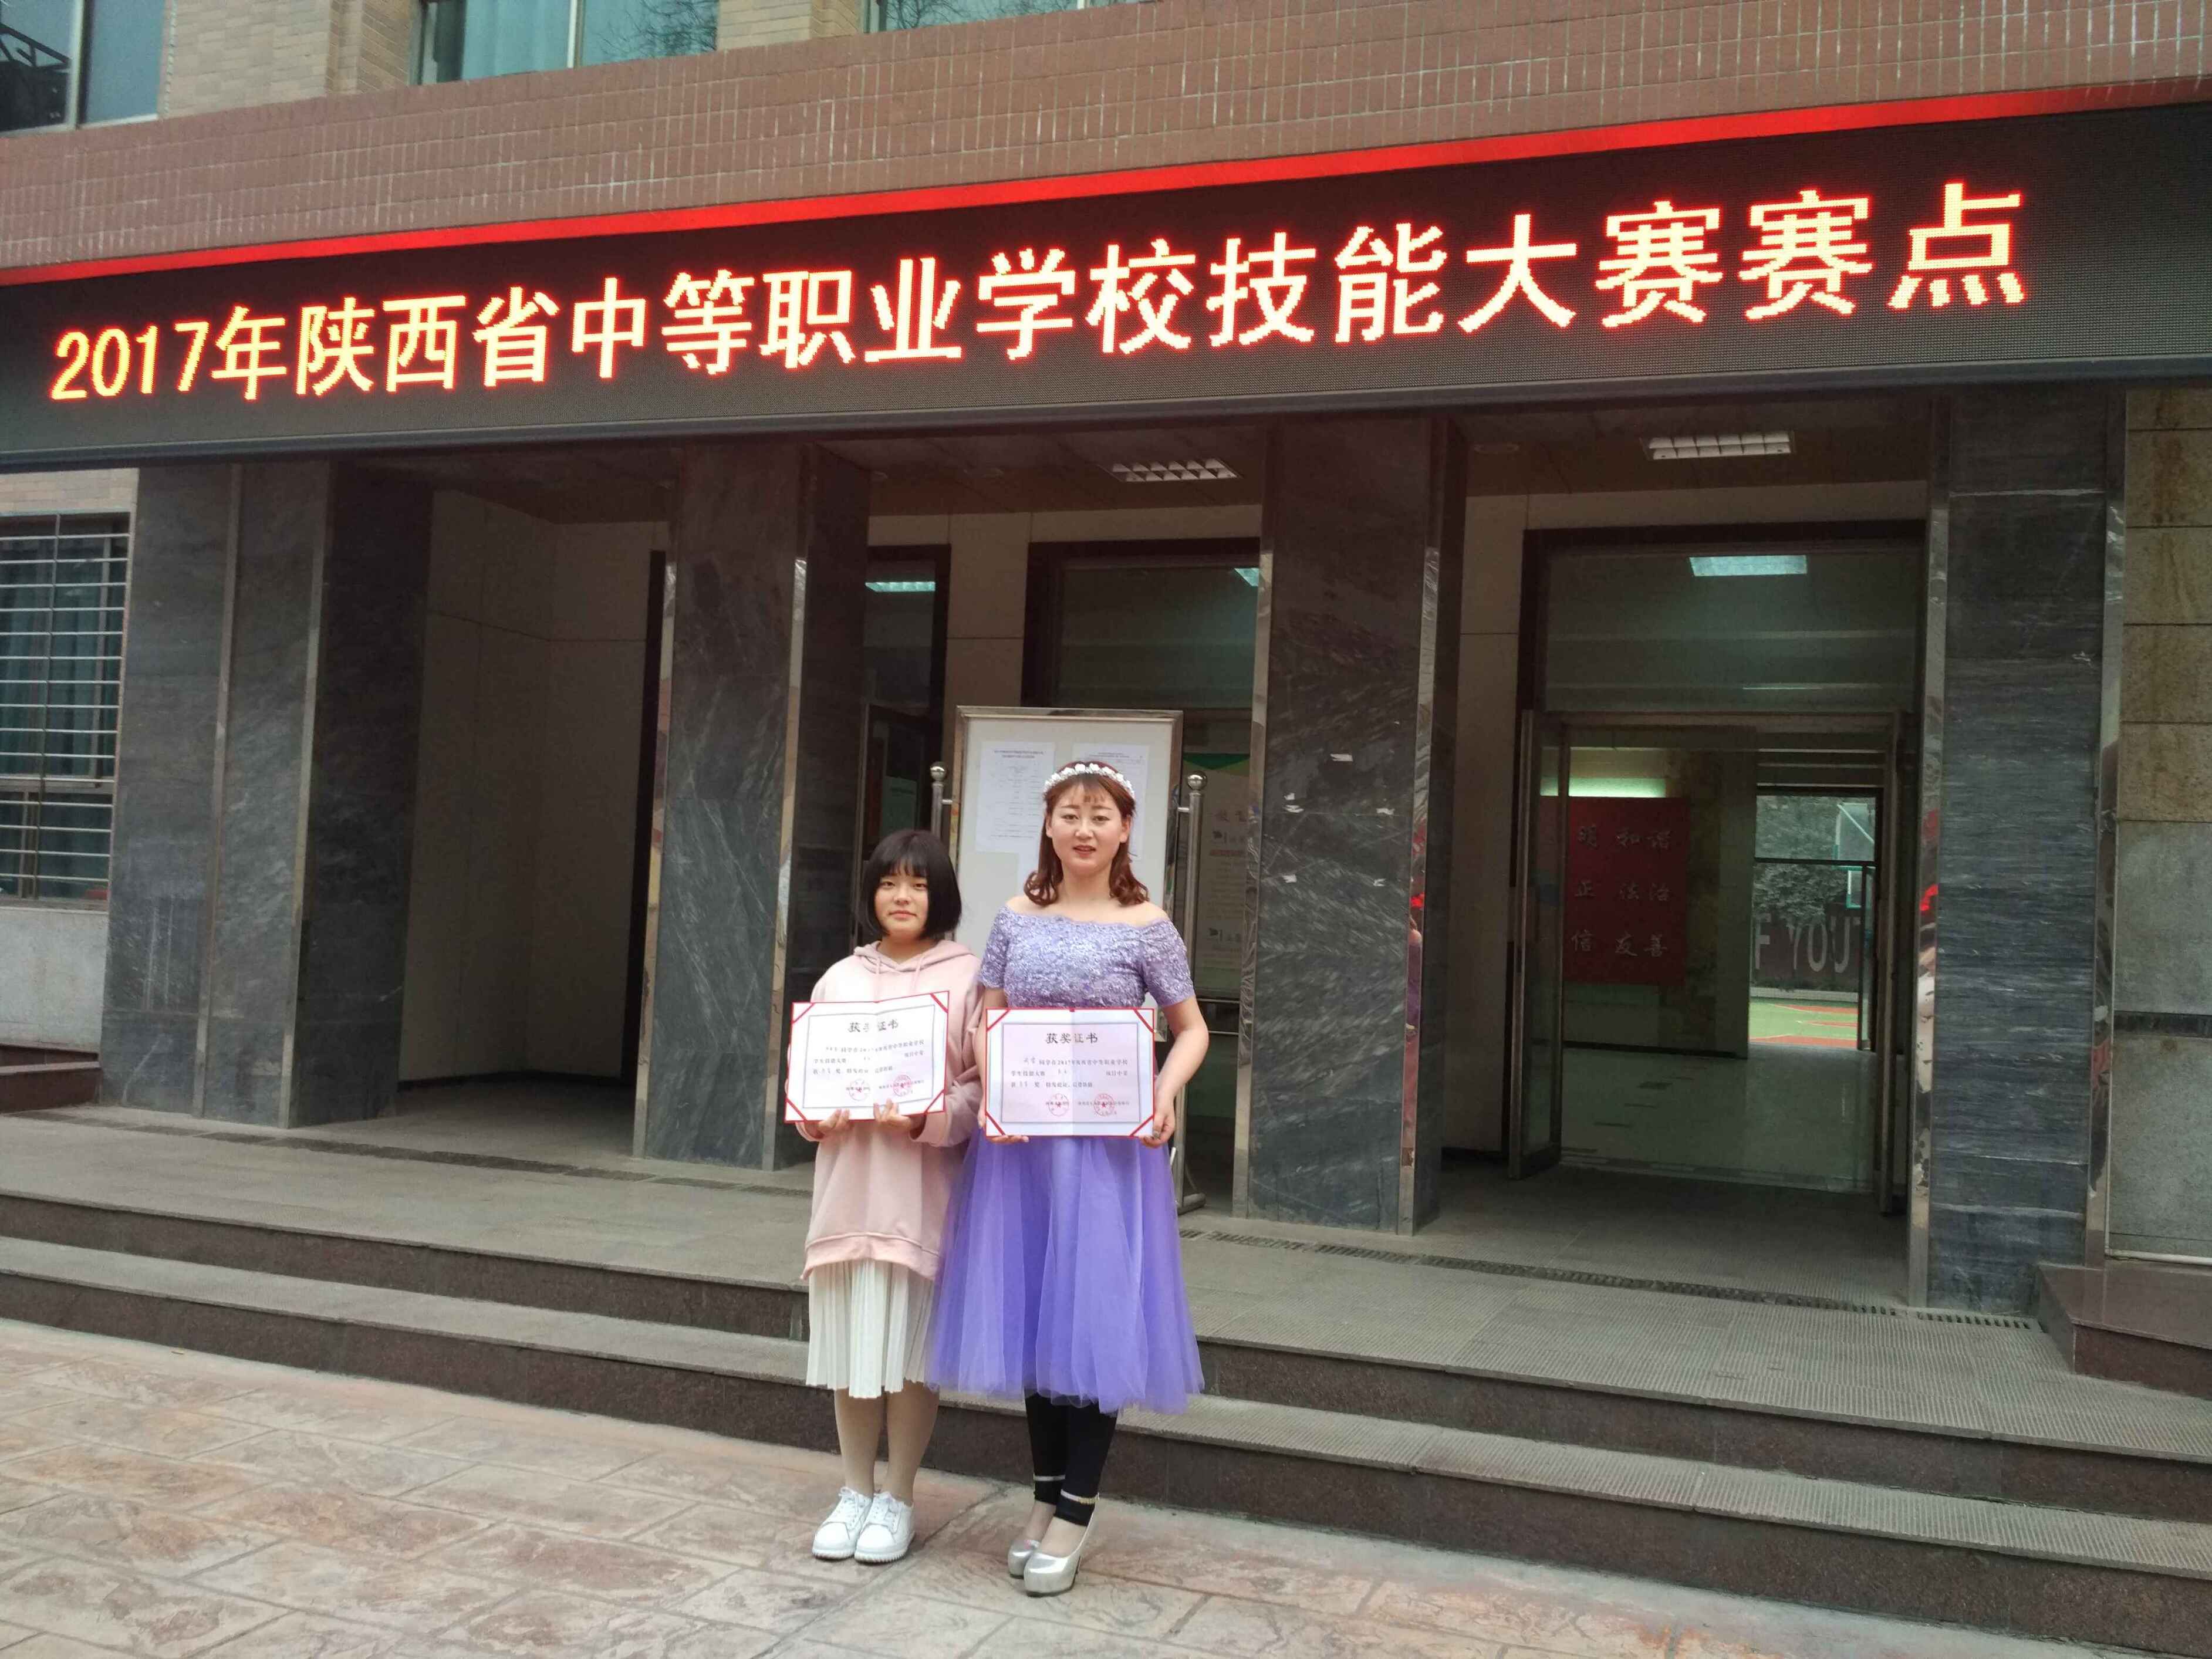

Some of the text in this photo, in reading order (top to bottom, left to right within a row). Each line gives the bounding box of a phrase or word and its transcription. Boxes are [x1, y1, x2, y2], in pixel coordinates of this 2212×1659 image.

[49, 181, 2026, 401] 2017年陕西省中等职业学校技能大赛赛点
[1045, 1032, 1098, 1044] 获奖证书
